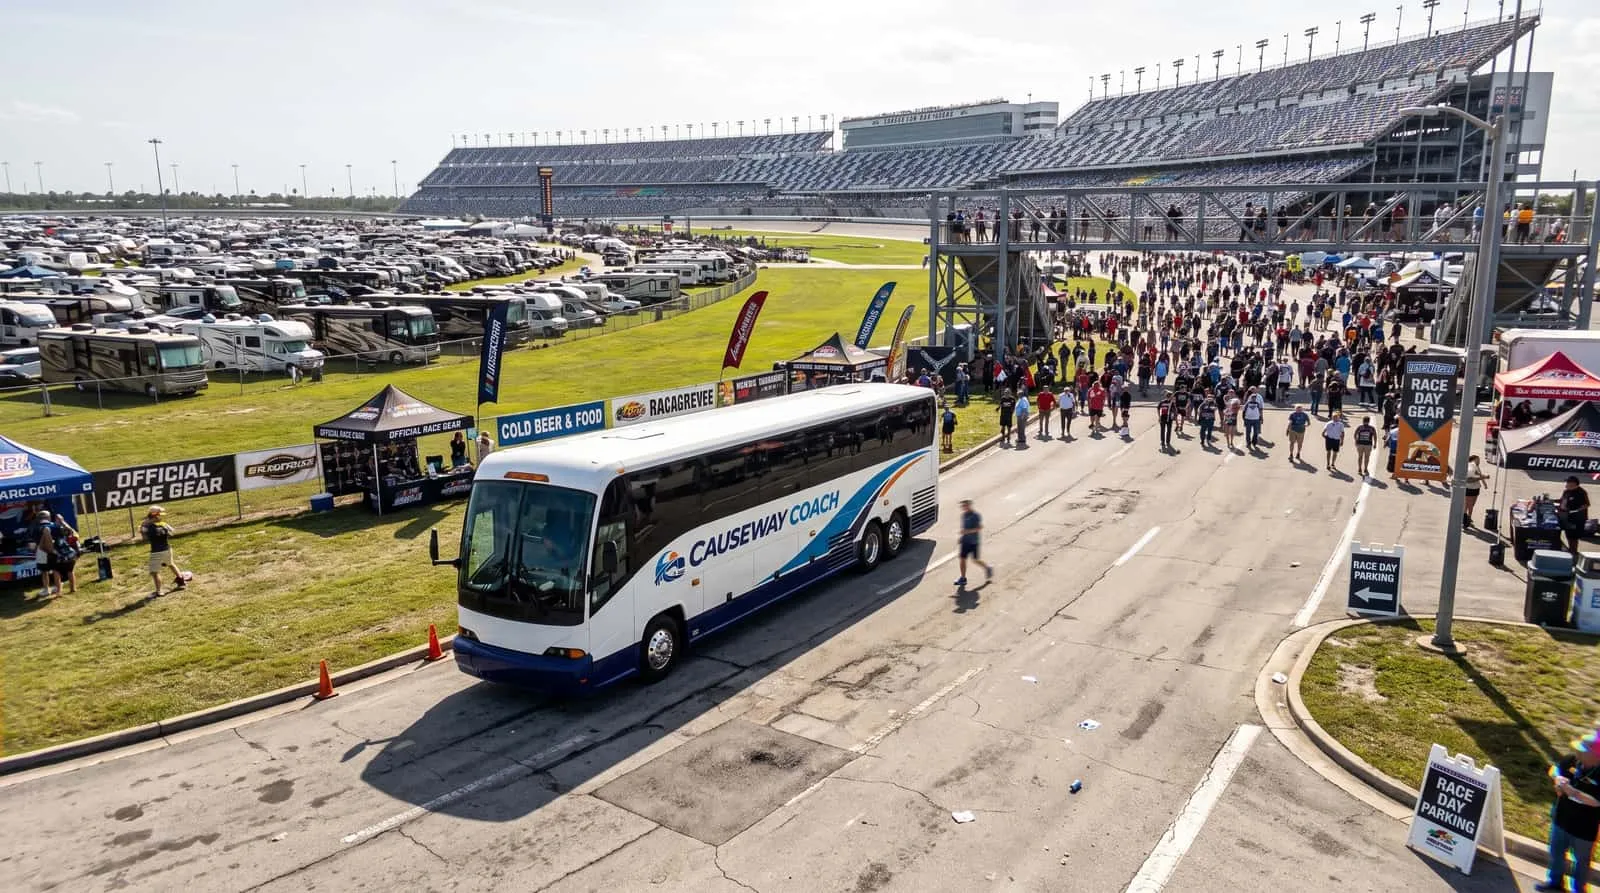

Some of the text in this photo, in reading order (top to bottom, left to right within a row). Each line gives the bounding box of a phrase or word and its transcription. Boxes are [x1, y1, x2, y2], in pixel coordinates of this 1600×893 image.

[1411, 378, 1448, 392] RACE
[650, 389, 713, 416] RACAGREVEE
[1414, 392, 1442, 405] DAY
[1408, 406, 1445, 419] GEAR
[389, 420, 462, 439] OFFICIAL RACE GEAR
[501, 420, 531, 440] COLD
[534, 414, 562, 433] BEER
[565, 414, 573, 428] &
[576, 408, 602, 427] FOOD
[1528, 457, 1584, 470] OFFICIAL
[117, 462, 210, 488] OFFICIAL
[106, 477, 223, 508] RACE GEAR
[689, 490, 840, 567] CAUSEWAY COACH
[1353, 560, 1398, 573] RACE DAY
[1354, 571, 1394, 582] PARKING
[1436, 777, 1475, 803] RACE
[1436, 792, 1466, 814] DAY
[1420, 801, 1476, 834] PARKING
